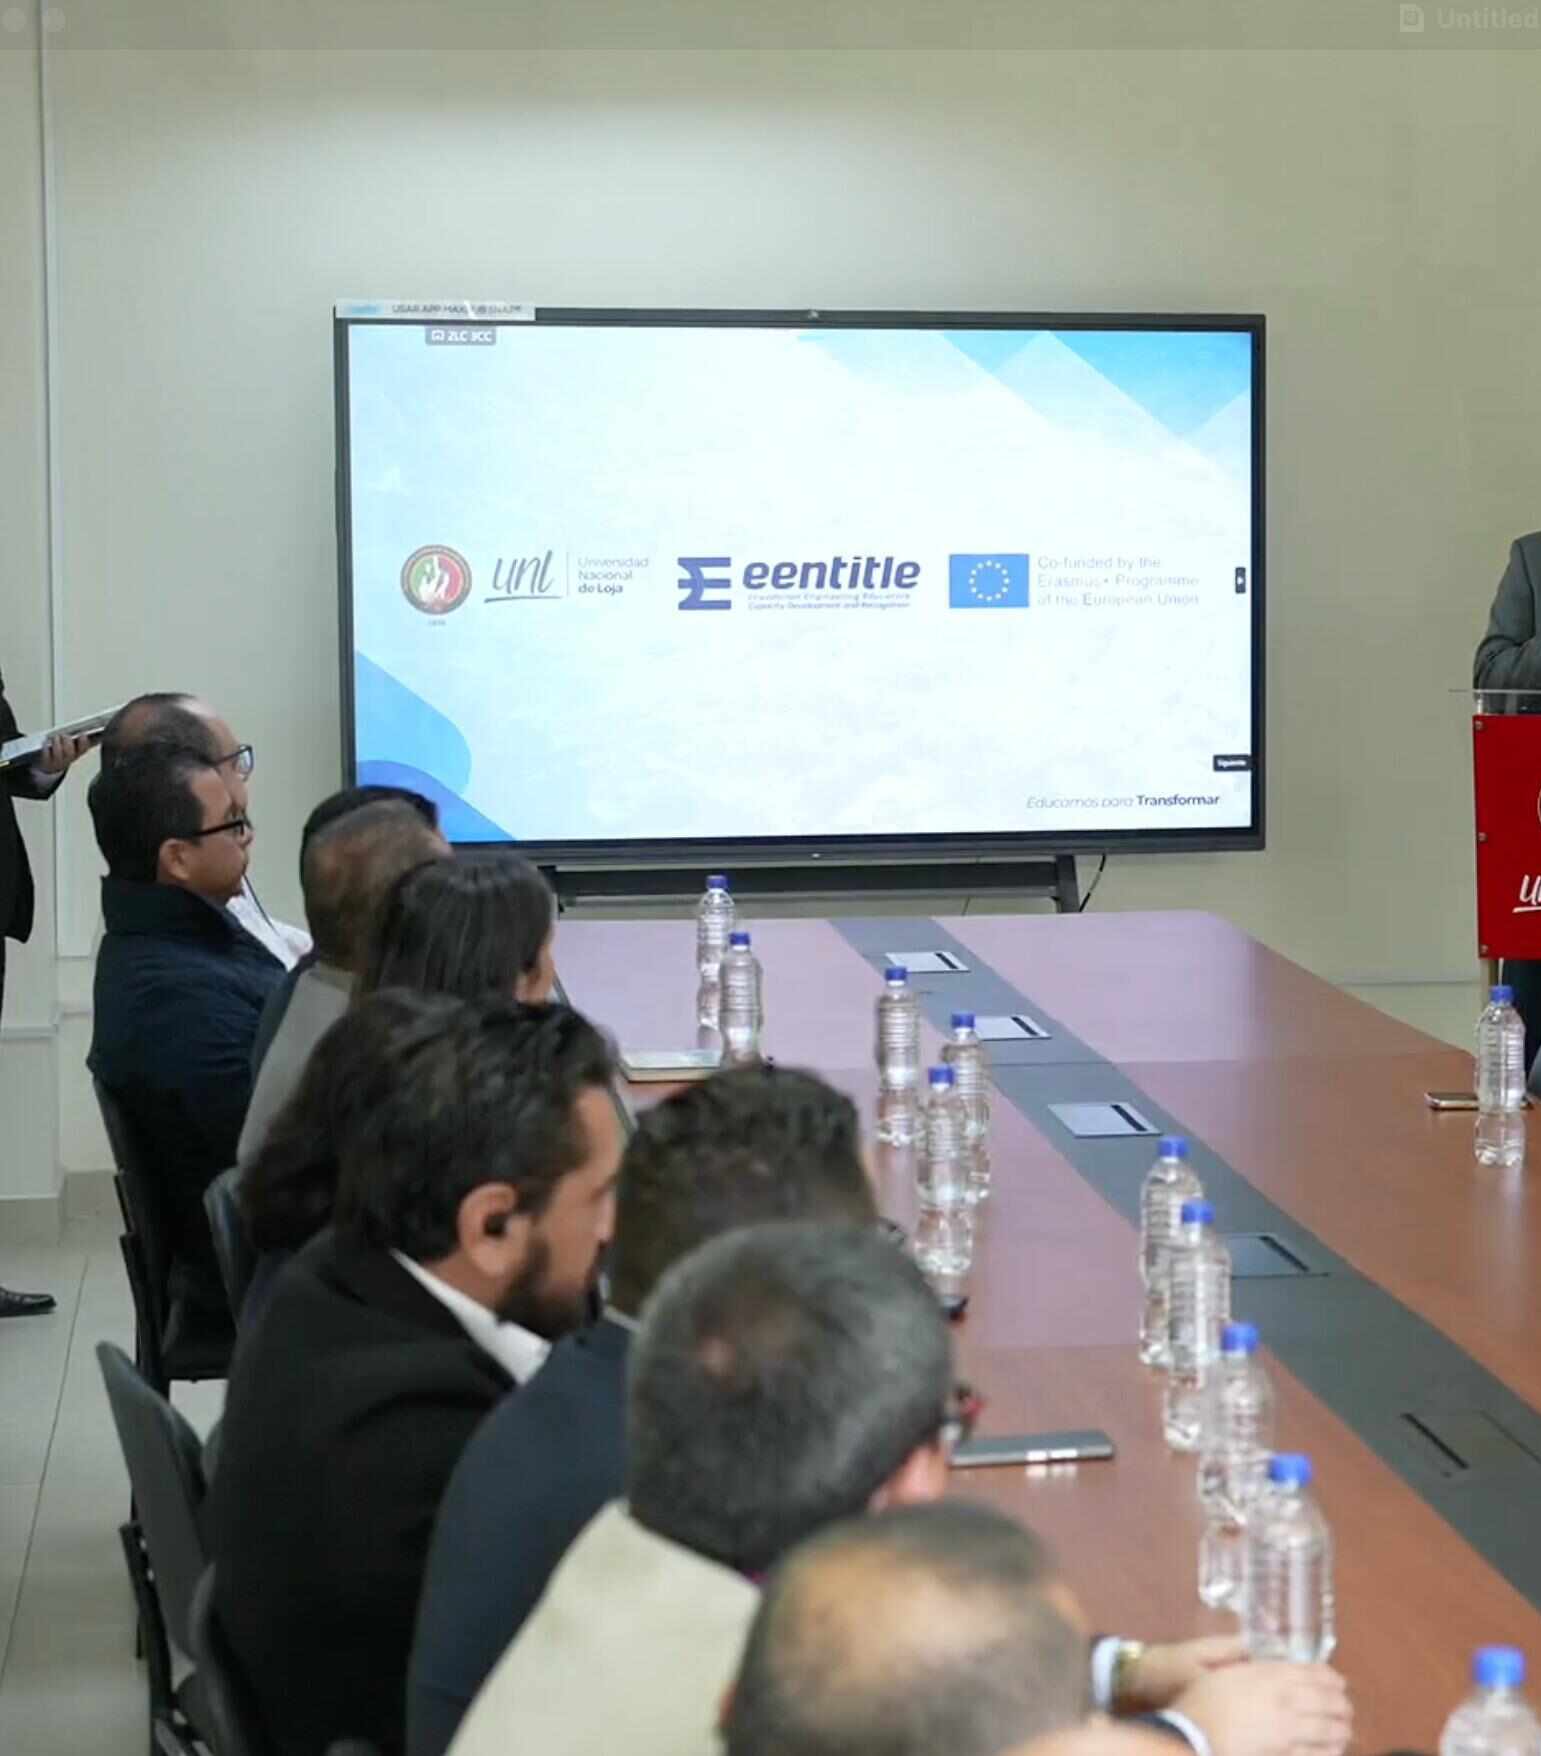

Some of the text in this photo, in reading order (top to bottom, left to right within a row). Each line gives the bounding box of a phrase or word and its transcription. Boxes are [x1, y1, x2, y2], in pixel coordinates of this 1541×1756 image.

[577, 557, 649, 568] Universidad
[1037, 556, 1161, 571] Co-funded by the
[578, 570, 633, 581] Nacional
[742, 556, 921, 590] eentitle
[1114, 574, 1200, 589] Programme
[578, 583, 623, 596] de Loja
[1036, 592, 1051, 606] of
[1082, 592, 1153, 607] European
[1157, 592, 1199, 606] Union
[1026, 793, 1220, 809] Educamos para Transformar
